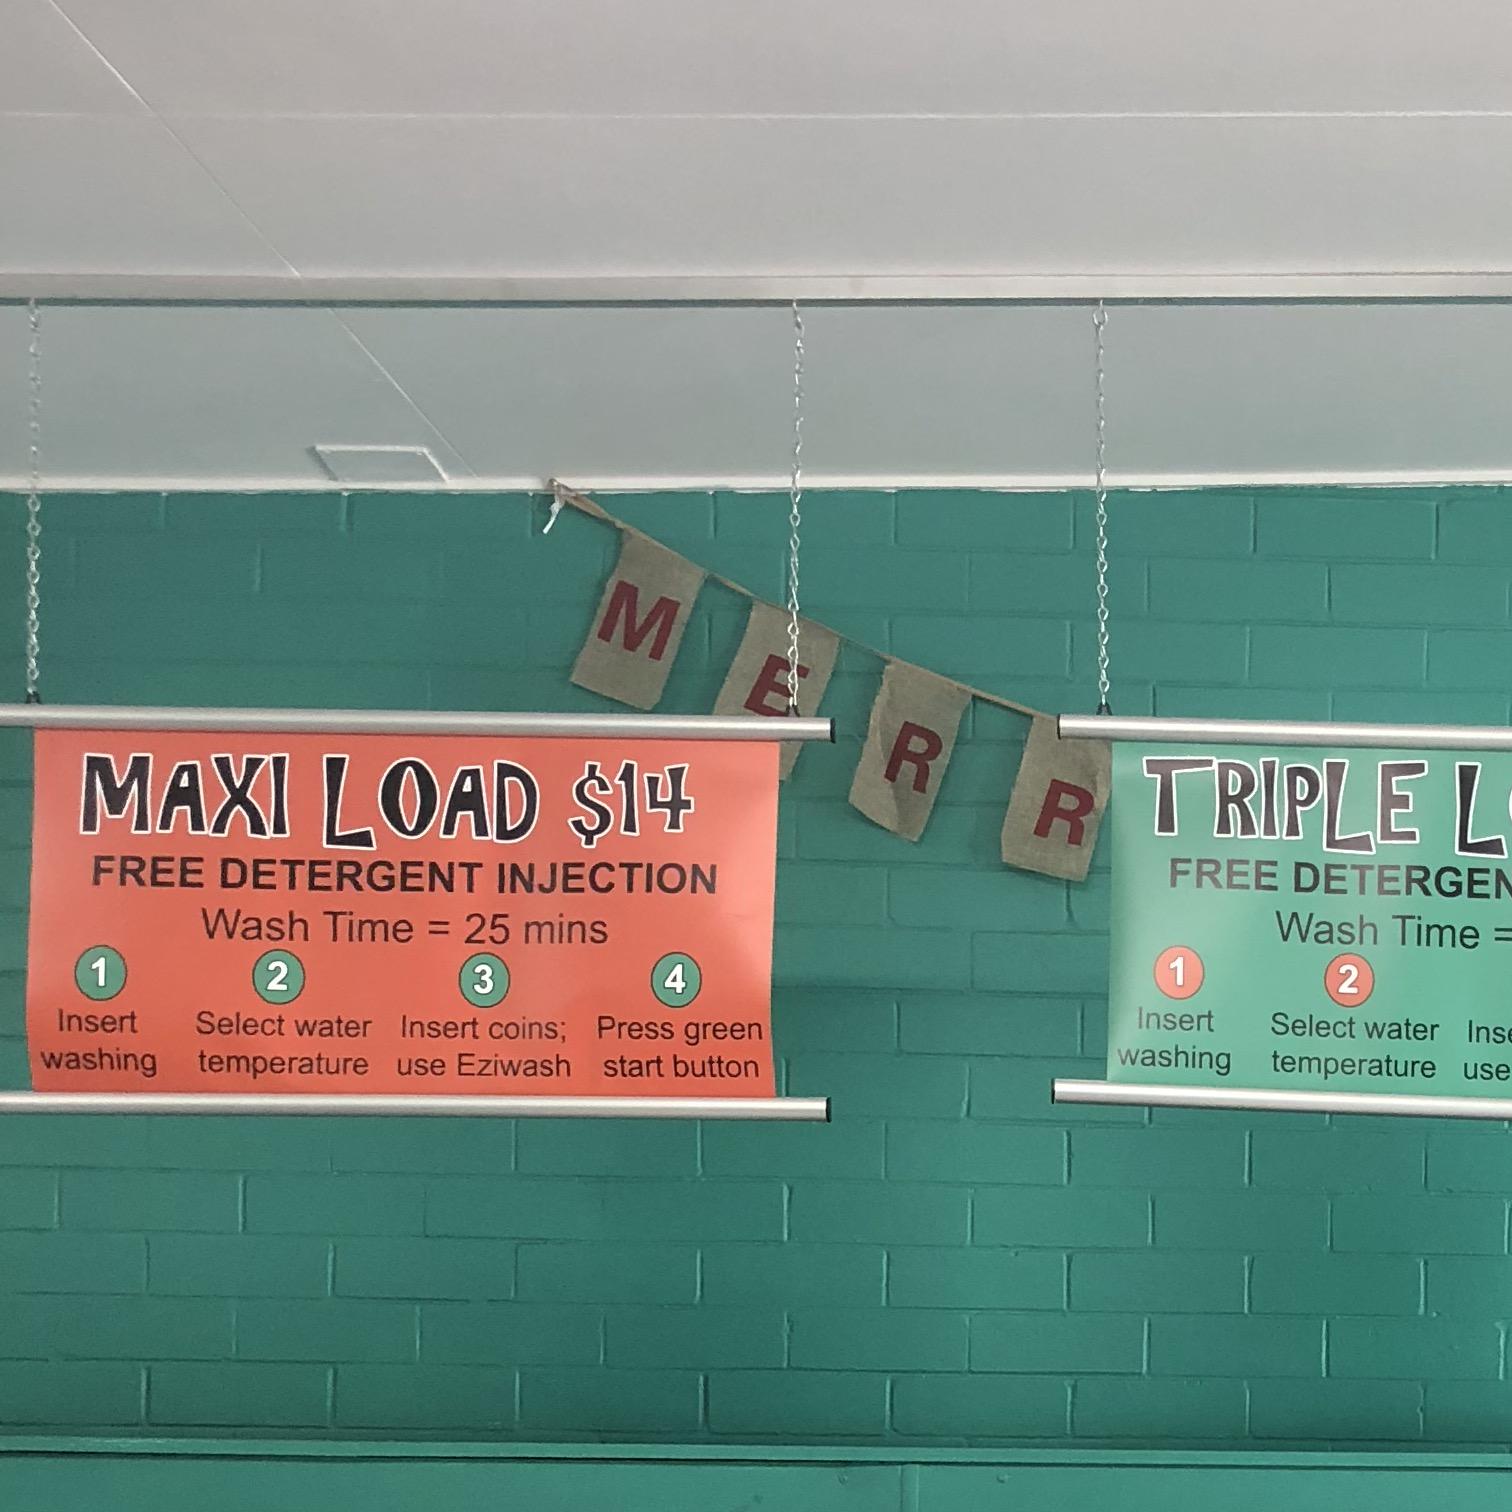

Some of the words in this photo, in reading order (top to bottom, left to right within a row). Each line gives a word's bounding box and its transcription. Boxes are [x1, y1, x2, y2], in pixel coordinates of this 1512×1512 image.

[78, 750, 291, 841] MAXI
[321, 754, 539, 851] LOAD
[568, 760, 695, 847] $14
[1142, 756, 1430, 856] TRIPLE
[91, 855, 204, 888] FREE
[220, 858, 483, 894] DETERGENT
[497, 862, 718, 895] INJECTION
[1169, 859, 1278, 892] FREE
[201, 907, 311, 943] Wash
[323, 908, 415, 944] Time
[464, 912, 511, 946] 25
[524, 914, 609, 946] mins
[1275, 910, 1379, 947] Wash
[1391, 914, 1481, 952] Time
[92, 956, 108, 987] 1
[267, 960, 288, 991] 2
[473, 964, 495, 995] 3
[663, 964, 687, 995] 4
[1168, 958, 1187, 986] 1
[1337, 965, 1359, 995] 2
[57, 1009, 138, 1035] Insert
[197, 1011, 288, 1040] Select
[294, 1016, 372, 1040] water
[400, 1015, 481, 1041] Insert
[487, 1016, 568, 1045] coins;
[597, 1016, 677, 1041] Press
[683, 1020, 763, 1049] green
[1137, 1007, 1215, 1033] Insert
[1271, 1012, 1359, 1042] Select
[1365, 1017, 1440, 1043] water
[41, 1047, 157, 1080] washing
[199, 1052, 369, 1081] temperature
[396, 1056, 447, 1078] use
[456, 1053, 571, 1080] Eziwash
[603, 1055, 667, 1080] start
[672, 1053, 760, 1080] button
[1118, 1044, 1232, 1078] washing
[1272, 1054, 1437, 1085] temperature
[1463, 1060, 1512, 1083] use
